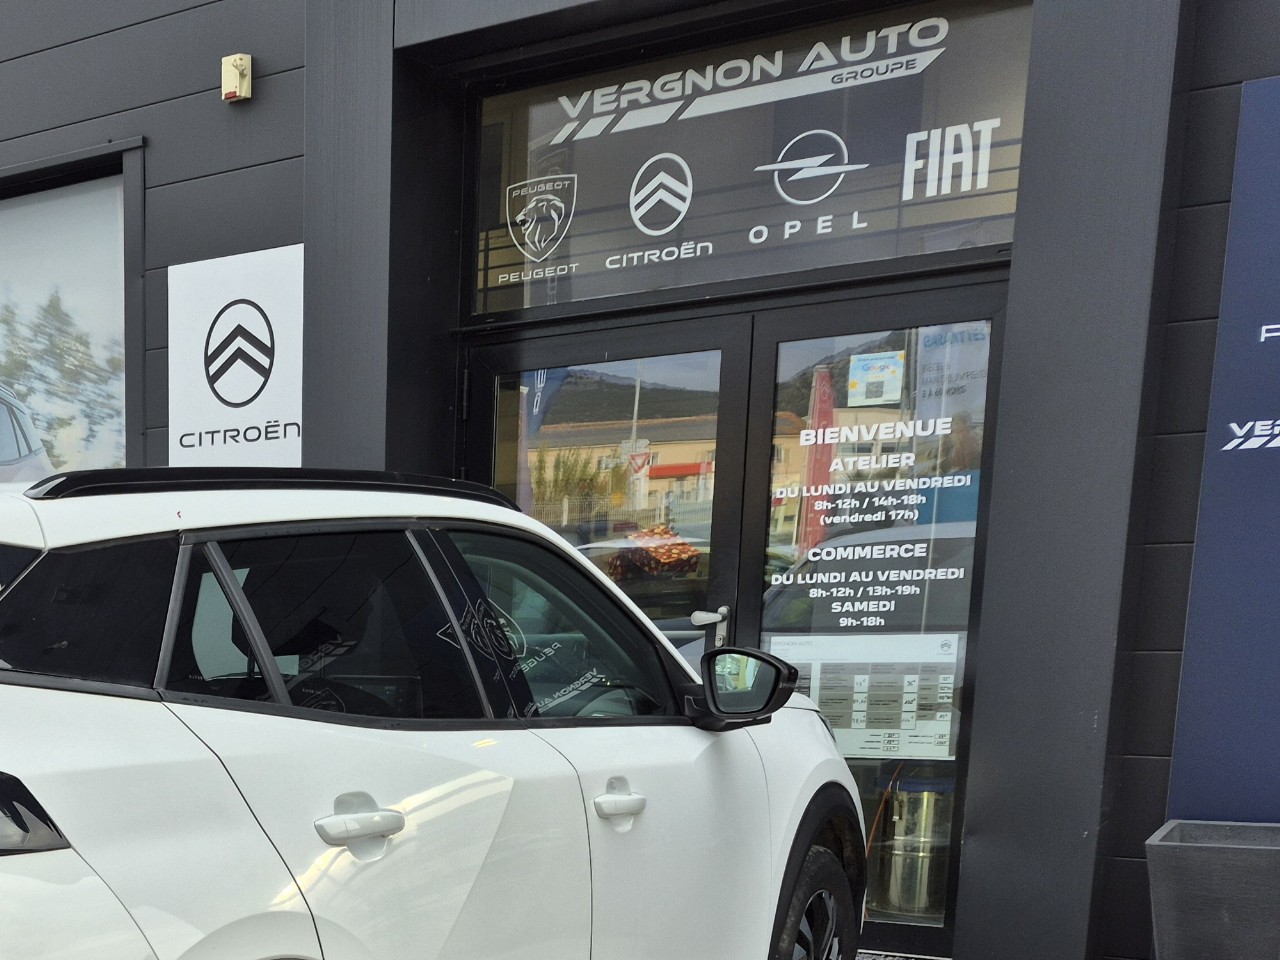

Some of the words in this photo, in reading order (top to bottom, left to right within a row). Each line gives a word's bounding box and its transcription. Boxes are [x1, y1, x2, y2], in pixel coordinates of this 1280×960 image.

[558, 51, 784, 118] VERGNON
[798, 17, 950, 72] AUTO
[831, 58, 918, 85] GROUPE
[902, 118, 1001, 201] FIAT
[511, 180, 572, 198] PEUGEOT
[748, 210, 869, 244] OPEL
[605, 241, 714, 269] CITROËN
[498, 262, 580, 284] PEUGEOT
[179, 420, 301, 448] CITROËN
[799, 417, 953, 446] BIENVENUE
[829, 453, 916, 472] ATELIER
[775, 486, 800, 499] DU
[802, 482, 852, 497] LUNDI
[854, 480, 880, 494] AU
[882, 475, 972, 492] VENDREDI
[814, 498, 860, 511] 8h-12h
[871, 494, 927, 508] 14h-18h
[820, 511, 886, 526] (vendredi
[888, 509, 919, 522] 17h)
[807, 543, 928, 562] COMMERCE
[771, 573, 794, 586] DU
[796, 571, 846, 585] LUNDI
[848, 570, 874, 583] AU
[875, 567, 965, 581] VENDREDI
[808, 586, 855, 598] 8h-12h
[866, 584, 921, 597] 13h-19h
[831, 600, 896, 613] SAMEDI
[838, 616, 885, 627] 9h-18h
